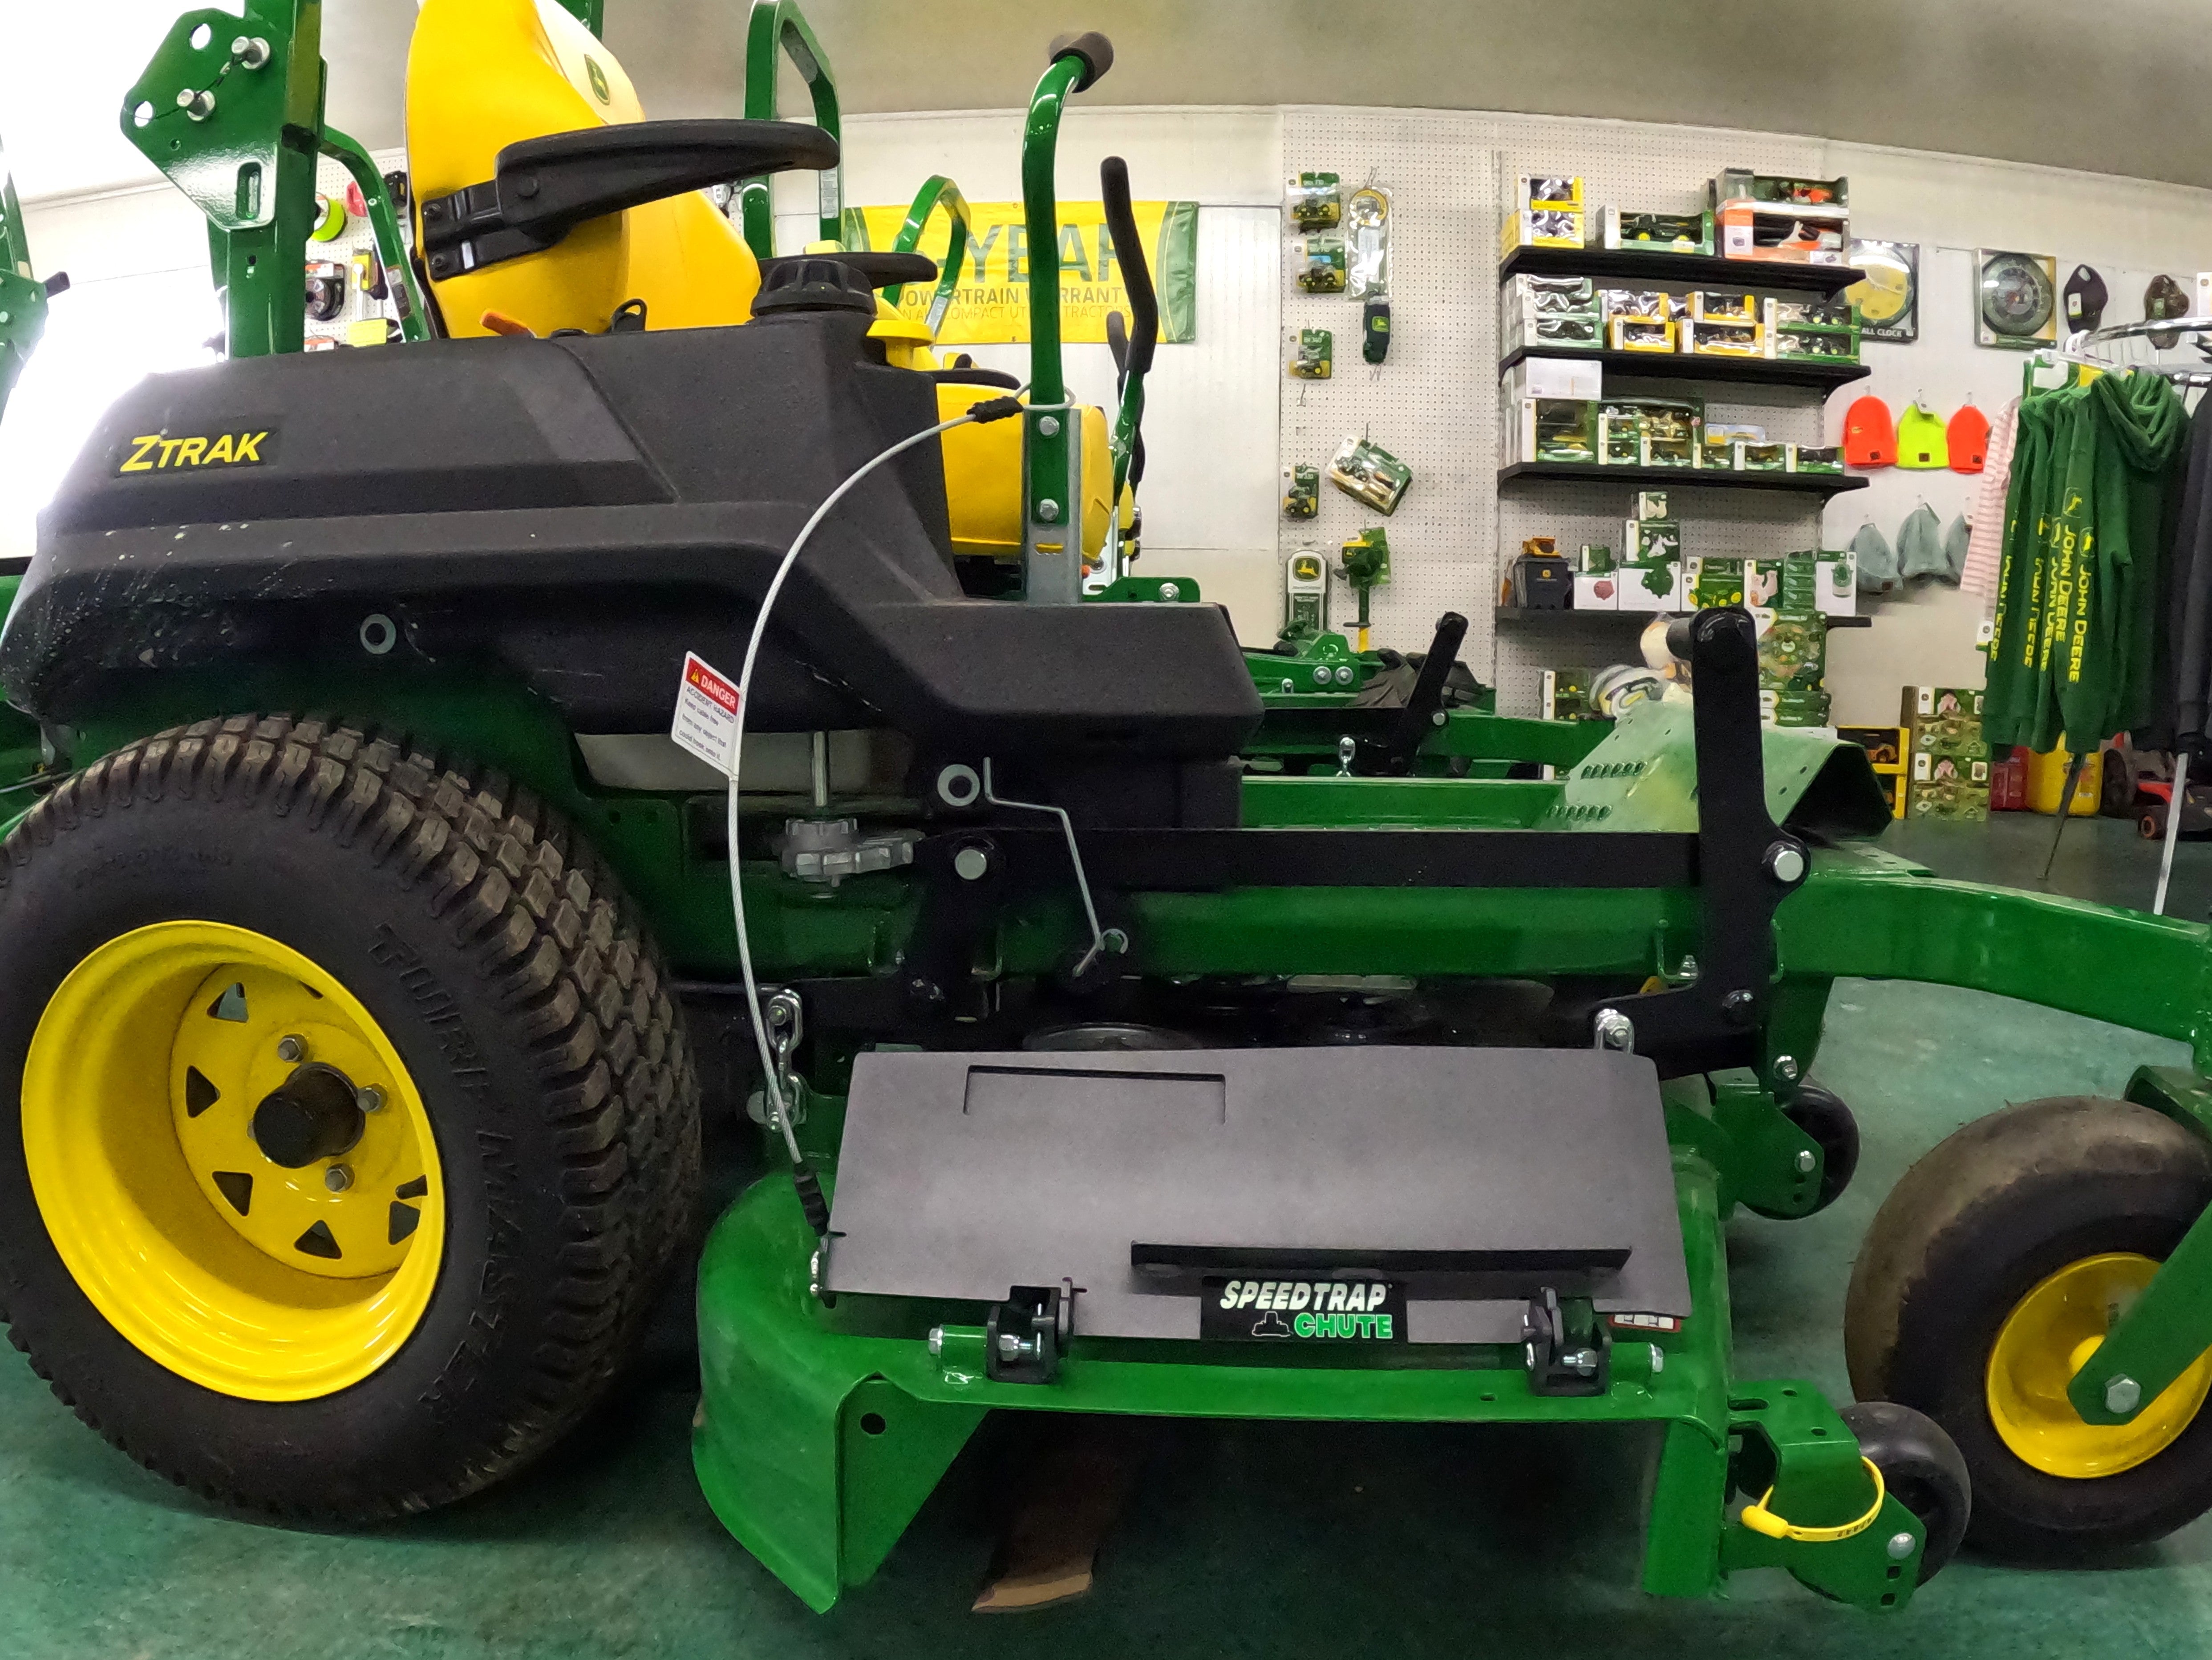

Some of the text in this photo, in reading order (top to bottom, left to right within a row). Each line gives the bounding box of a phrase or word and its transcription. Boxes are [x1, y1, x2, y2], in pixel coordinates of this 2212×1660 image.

[899, 286, 1131, 308] OWRTRAIN RRANT
[947, 306, 1004, 320] OMPACT
[1063, 305, 1131, 319] TRACTS
[1877, 328, 1902, 338] CLOCK
[120, 431, 268, 472] ZTRAK
[2055, 524, 2076, 643] JOHN DEERE
[2069, 564, 2091, 683] JOHN DEERE
[701, 674, 736, 709] DANGER
[1220, 1280, 1386, 1312] SPEEDTRAP
[1294, 1312, 1393, 1340] CHUTE
